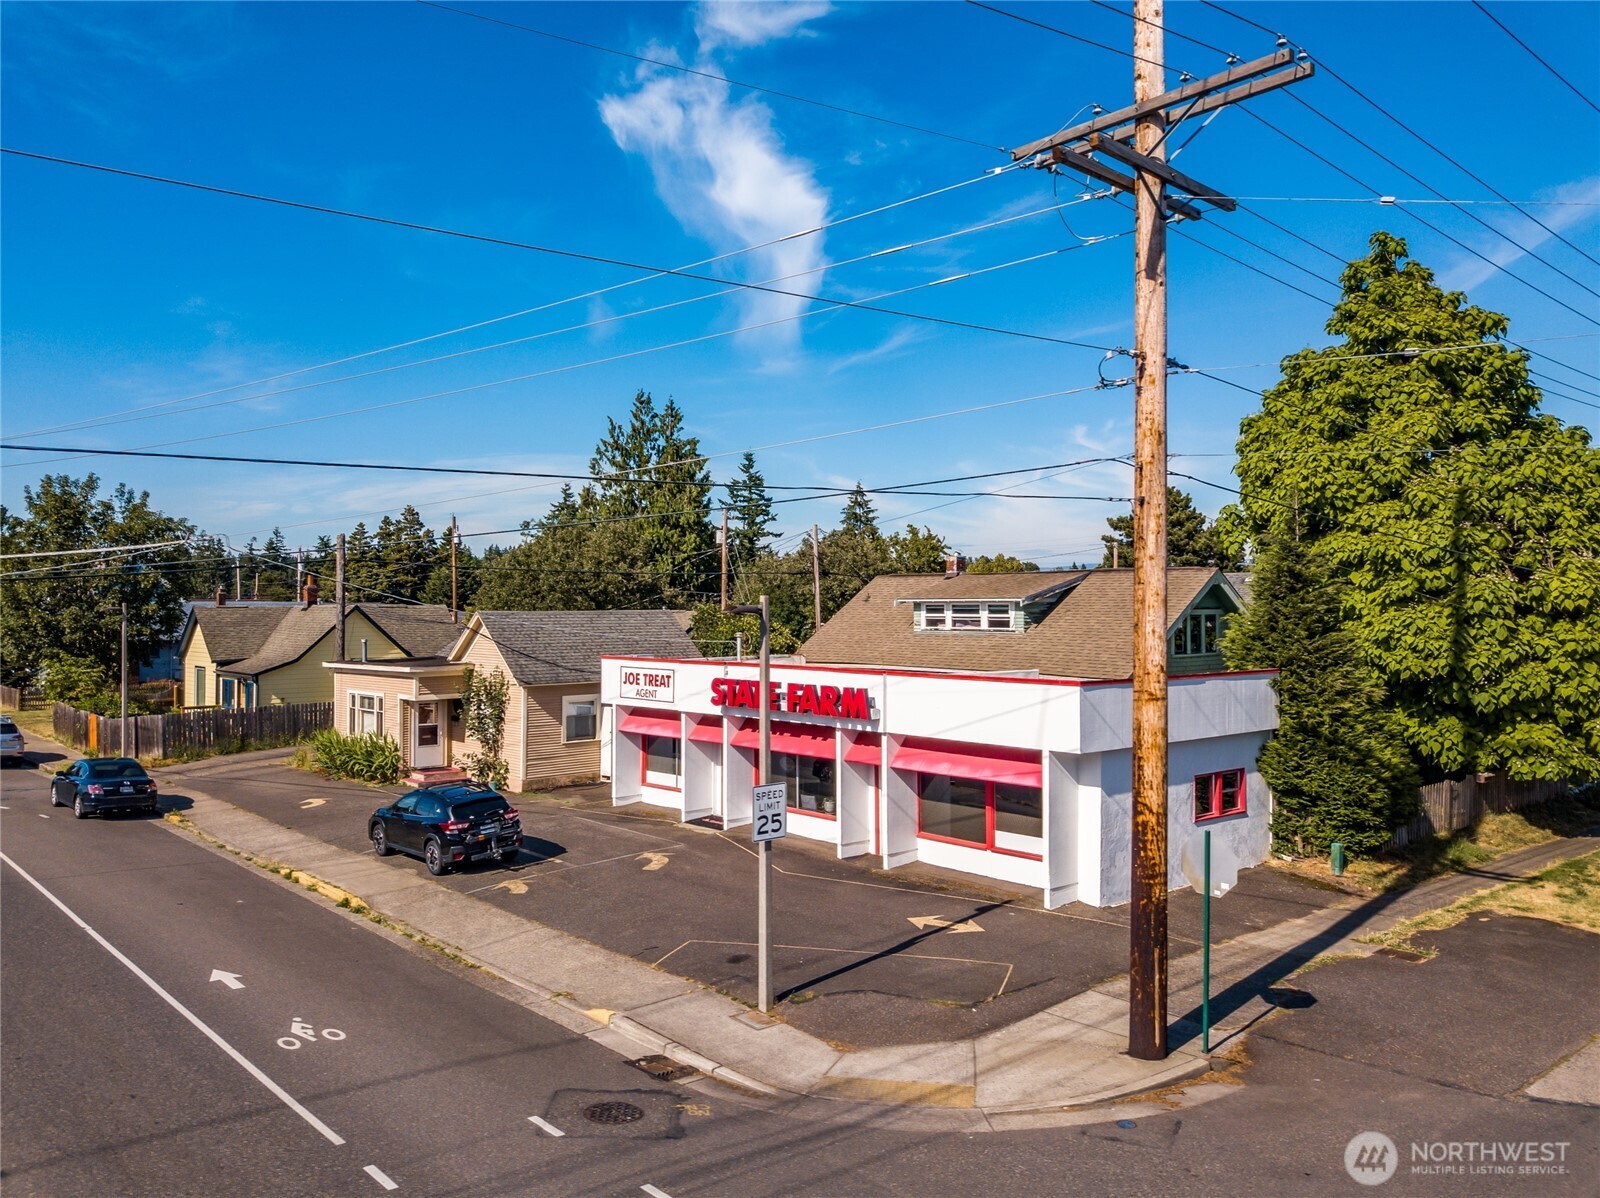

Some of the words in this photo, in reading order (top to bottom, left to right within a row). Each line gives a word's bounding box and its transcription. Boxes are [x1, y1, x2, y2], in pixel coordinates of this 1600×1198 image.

[623, 672, 640, 685] JOE
[643, 673, 671, 688] TREAT
[635, 688, 657, 698] AGENT
[711, 678, 779, 711] STATE
[787, 683, 868, 721] FARM
[756, 790, 783, 801] SPEED
[759, 801, 780, 812] LIMIT
[757, 812, 782, 835] 25
